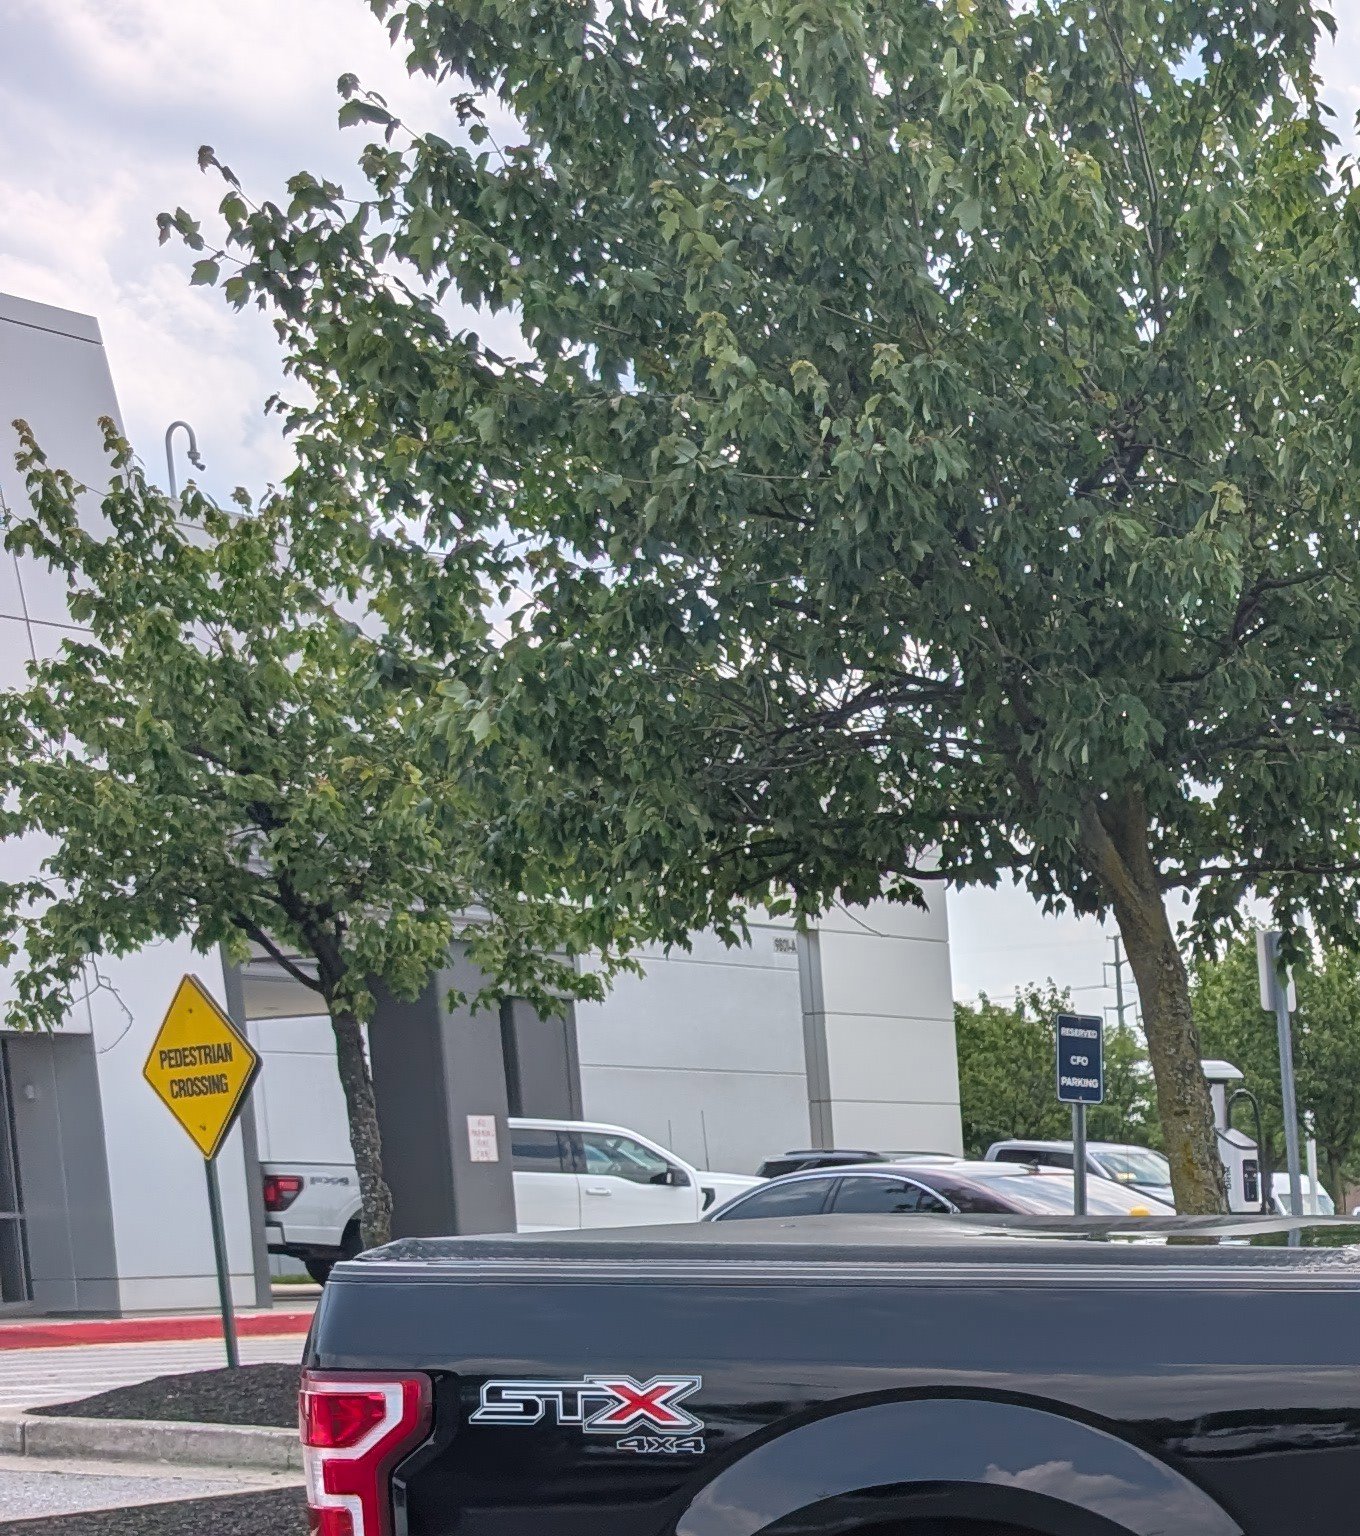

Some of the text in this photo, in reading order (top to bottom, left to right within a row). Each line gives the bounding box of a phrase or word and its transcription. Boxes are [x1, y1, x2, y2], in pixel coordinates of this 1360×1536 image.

[159, 1042, 233, 1070] PEDESTRIAN
[1070, 1055, 1089, 1067] CFO
[169, 1073, 229, 1099] CROSSING
[1060, 1075, 1099, 1089] PARKING
[469, 1375, 705, 1434] STX
